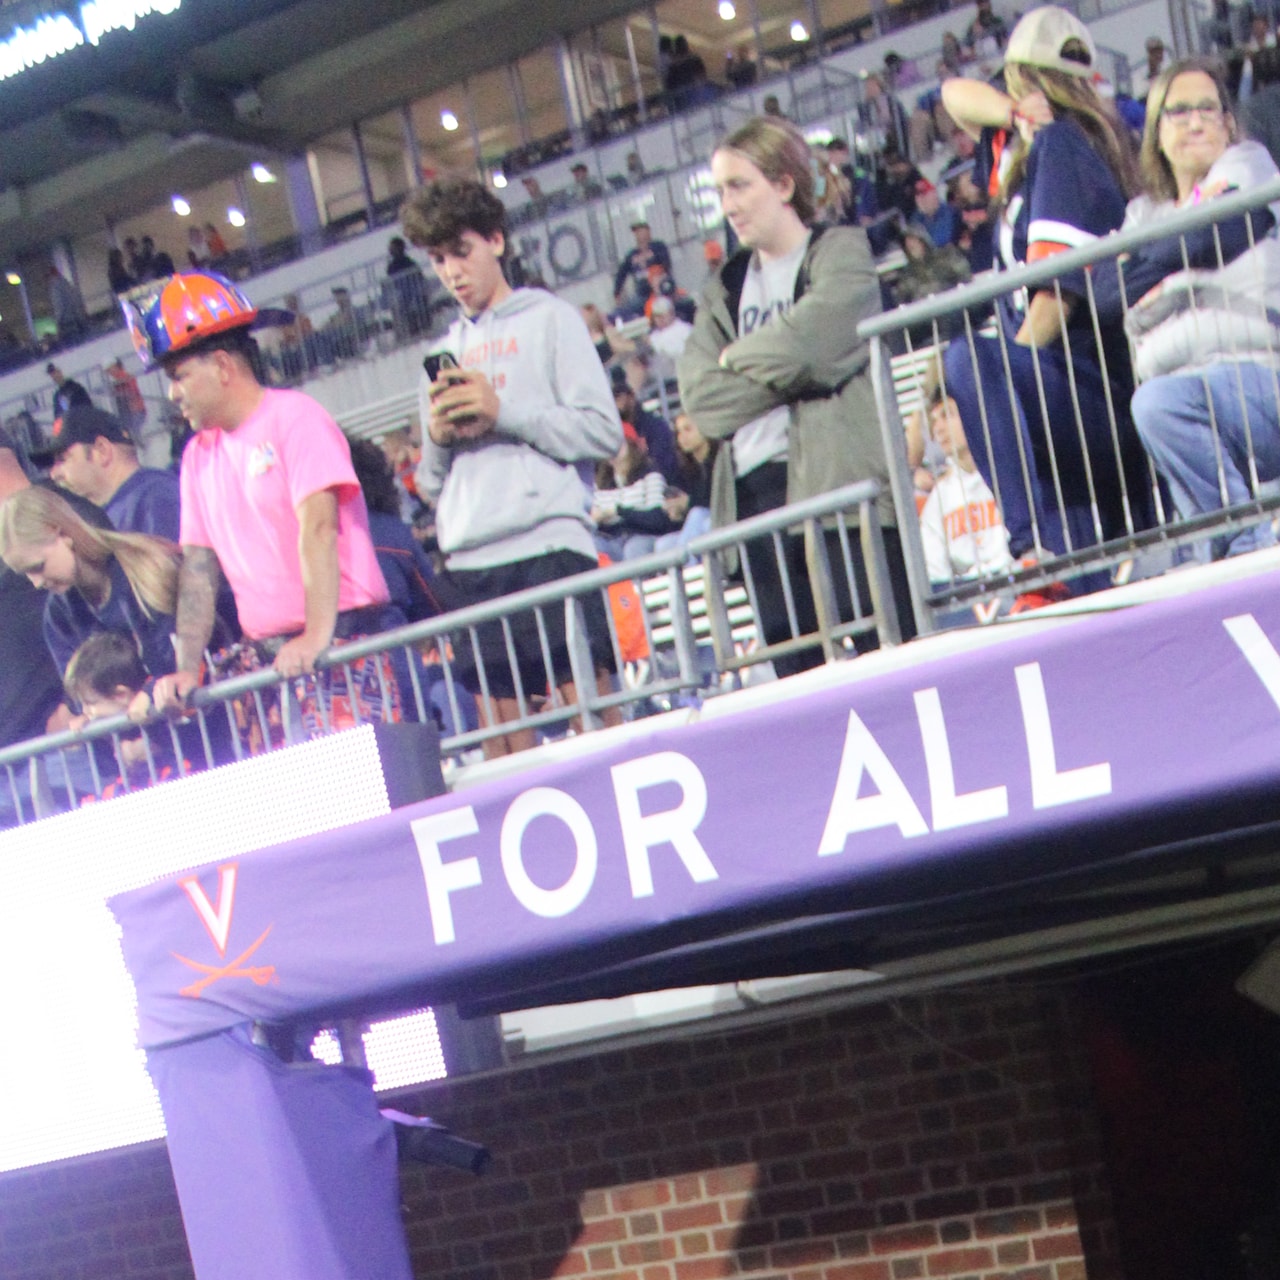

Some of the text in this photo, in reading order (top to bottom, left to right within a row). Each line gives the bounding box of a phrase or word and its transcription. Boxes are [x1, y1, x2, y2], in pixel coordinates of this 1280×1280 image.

[176, 861, 239, 960] V
[411, 751, 719, 946] FOR
[817, 662, 1112, 857] ALL
